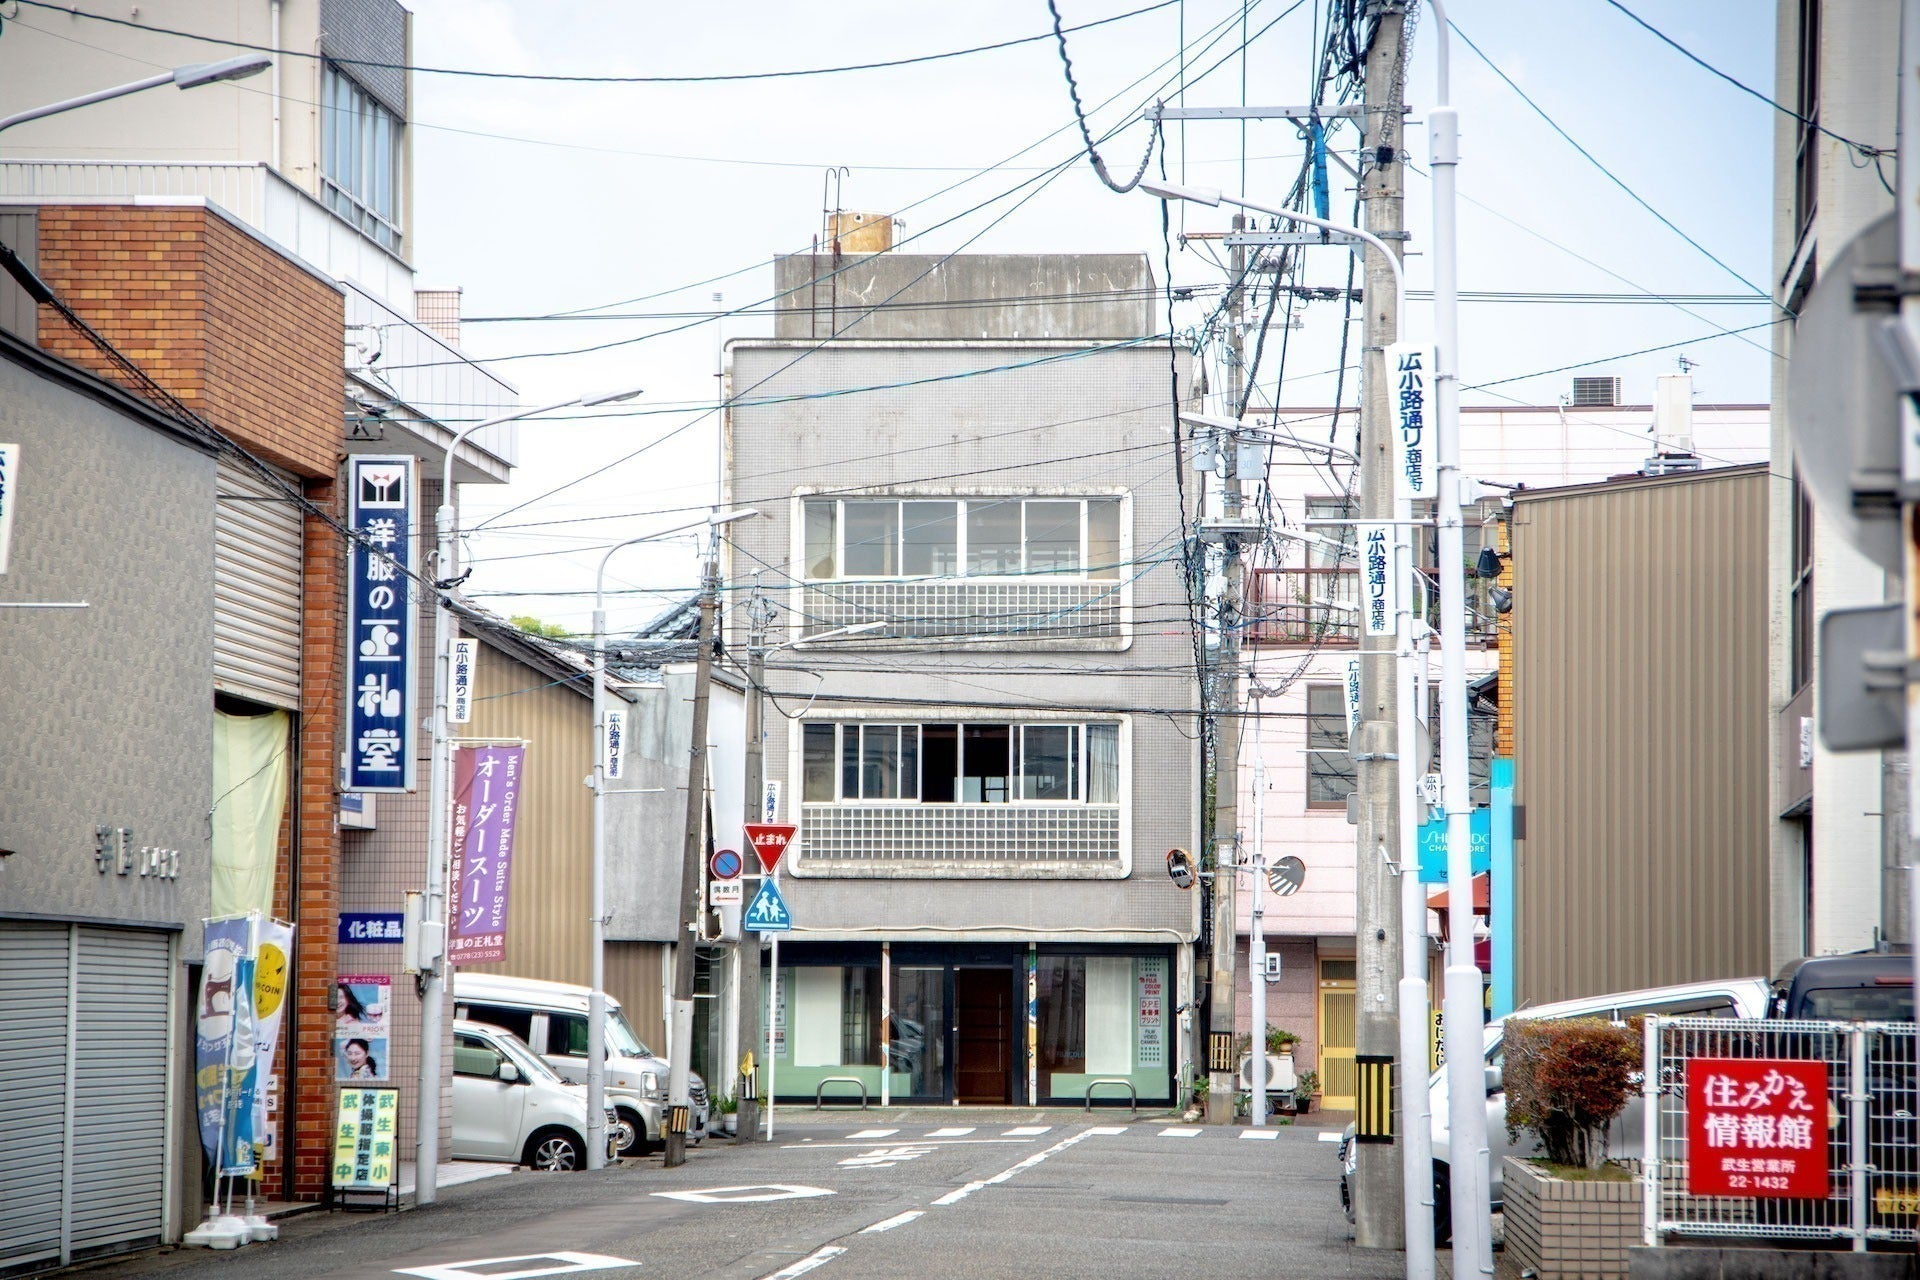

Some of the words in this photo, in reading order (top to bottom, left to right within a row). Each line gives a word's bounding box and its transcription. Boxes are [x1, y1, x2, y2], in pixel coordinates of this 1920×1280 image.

[455, 642, 469, 720] 広小路通り商店街
[506, 755, 519, 788] Men's
[502, 791, 515, 825] Order
[464, 756, 500, 929] オーダースーツ
[498, 828, 512, 858] Made
[755, 834, 787, 846] 止まれ
[495, 861, 508, 892] Suits
[491, 896, 504, 927] Style
[348, 919, 401, 938] 化粧品
[1703, 1069, 1814, 1111] 住みかえ
[335, 1094, 358, 1179] 武生一中
[355, 1093, 375, 1181] 体操服指定店
[372, 1094, 394, 1180] 武生東小
[1704, 1112, 1814, 1149] 情報館
[1721, 1157, 1796, 1174] 武生営業所
[1728, 1175, 1789, 1190] 22-1432
